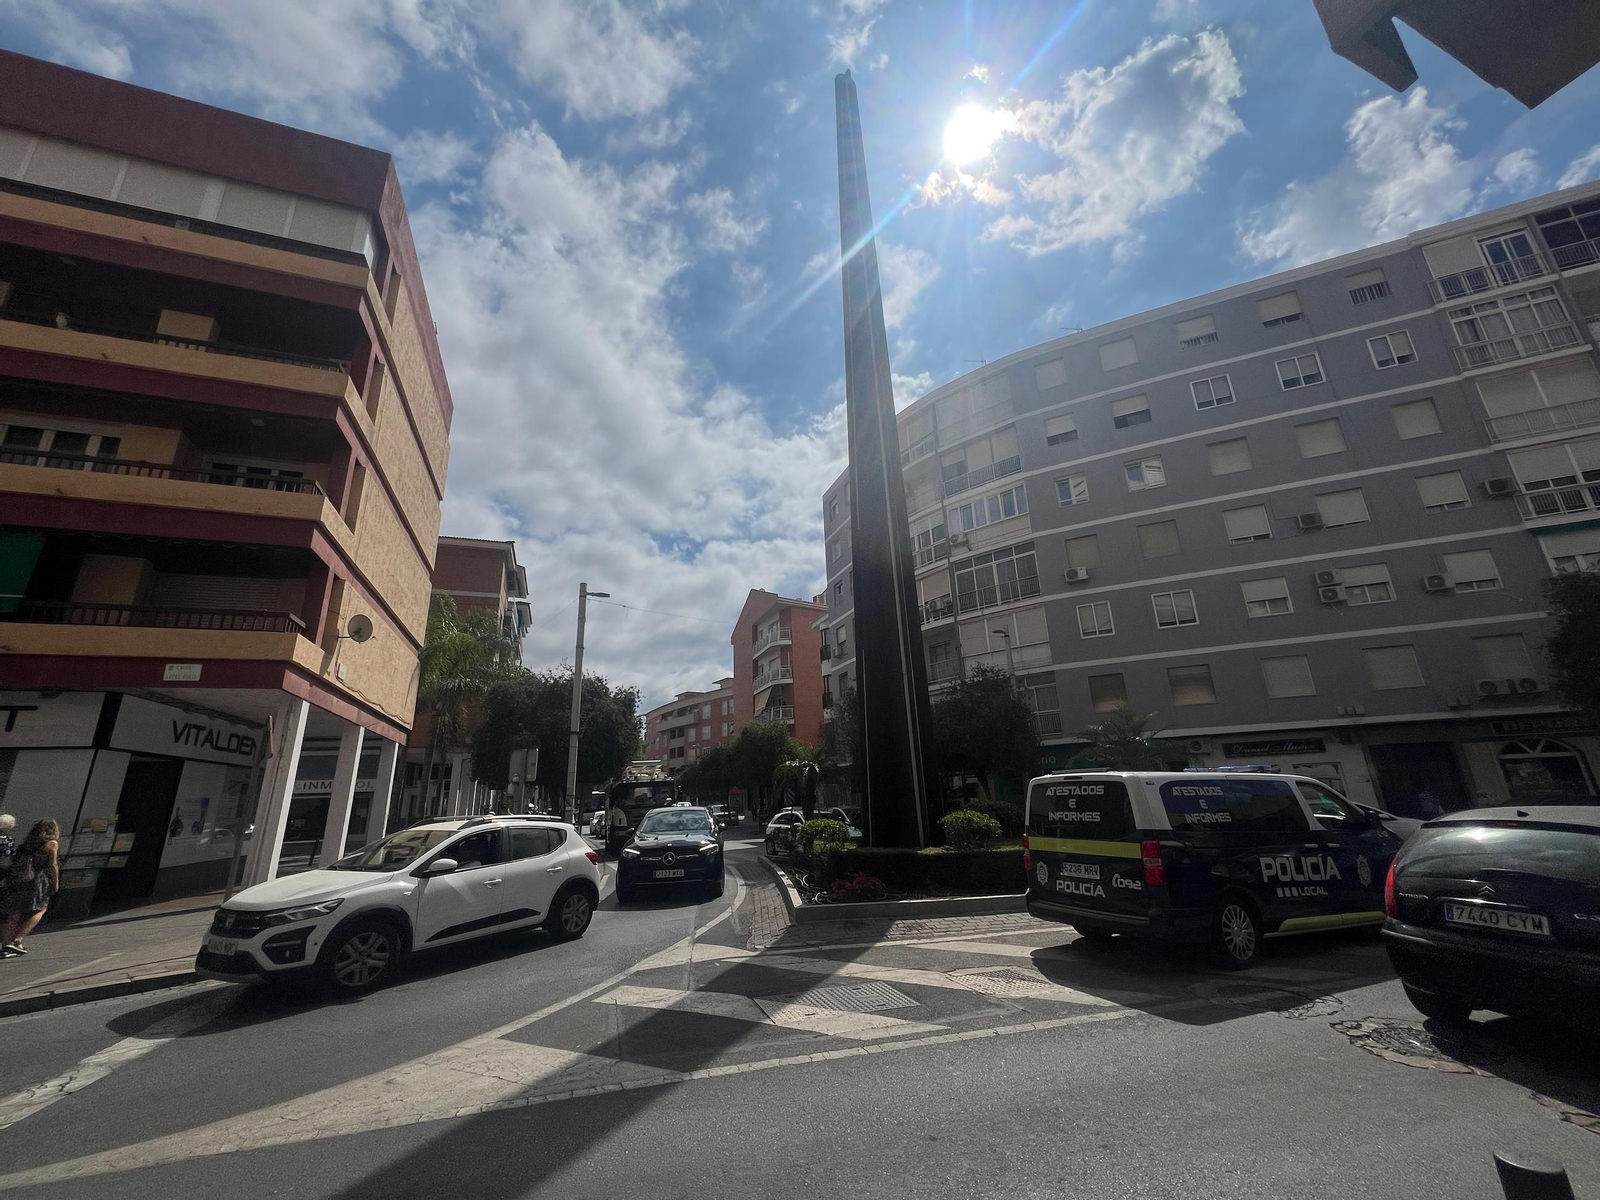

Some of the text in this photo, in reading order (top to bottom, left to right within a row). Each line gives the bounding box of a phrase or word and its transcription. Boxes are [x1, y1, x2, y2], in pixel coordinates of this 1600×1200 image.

[1045, 785, 1105, 797] ATESTADOS
[1172, 786, 1224, 797] ATESTADOS
[1068, 798, 1077, 808] E
[1199, 799, 1208, 809] E
[1048, 811, 1101, 822] INFORMES
[1184, 812, 1232, 824] INFORMES
[1064, 863, 1082, 874] 5236
[1259, 853, 1342, 883] POLICÍA
[1056, 880, 1106, 898] POLICÍA
[1298, 886, 1328, 896] LOCAL
[1455, 906, 1544, 932] 7440 CYM
